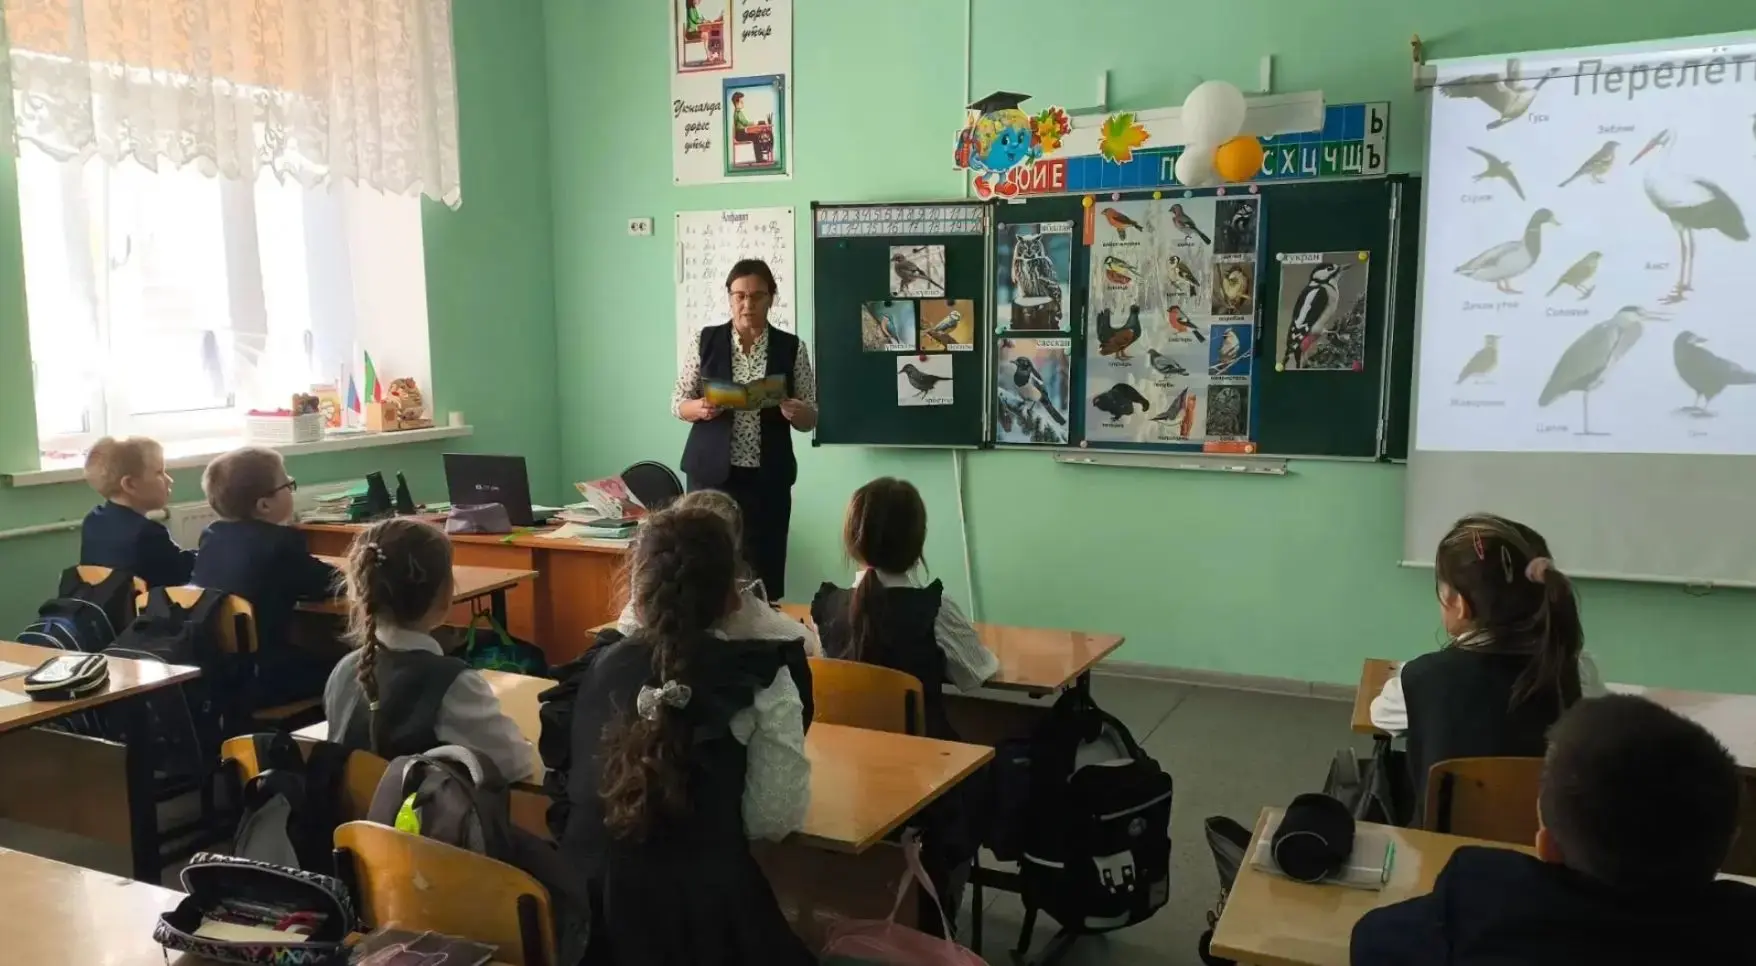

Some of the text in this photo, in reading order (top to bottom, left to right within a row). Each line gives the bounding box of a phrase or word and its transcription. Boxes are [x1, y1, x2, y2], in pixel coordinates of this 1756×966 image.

[1574, 47, 1756, 101] Перелёт
[1052, 164, 1063, 188] Е
[1281, 148, 1295, 174] Х
[1302, 148, 1317, 175] Ц
[1324, 146, 1337, 172] Ч
[1342, 145, 1362, 173] Щ
